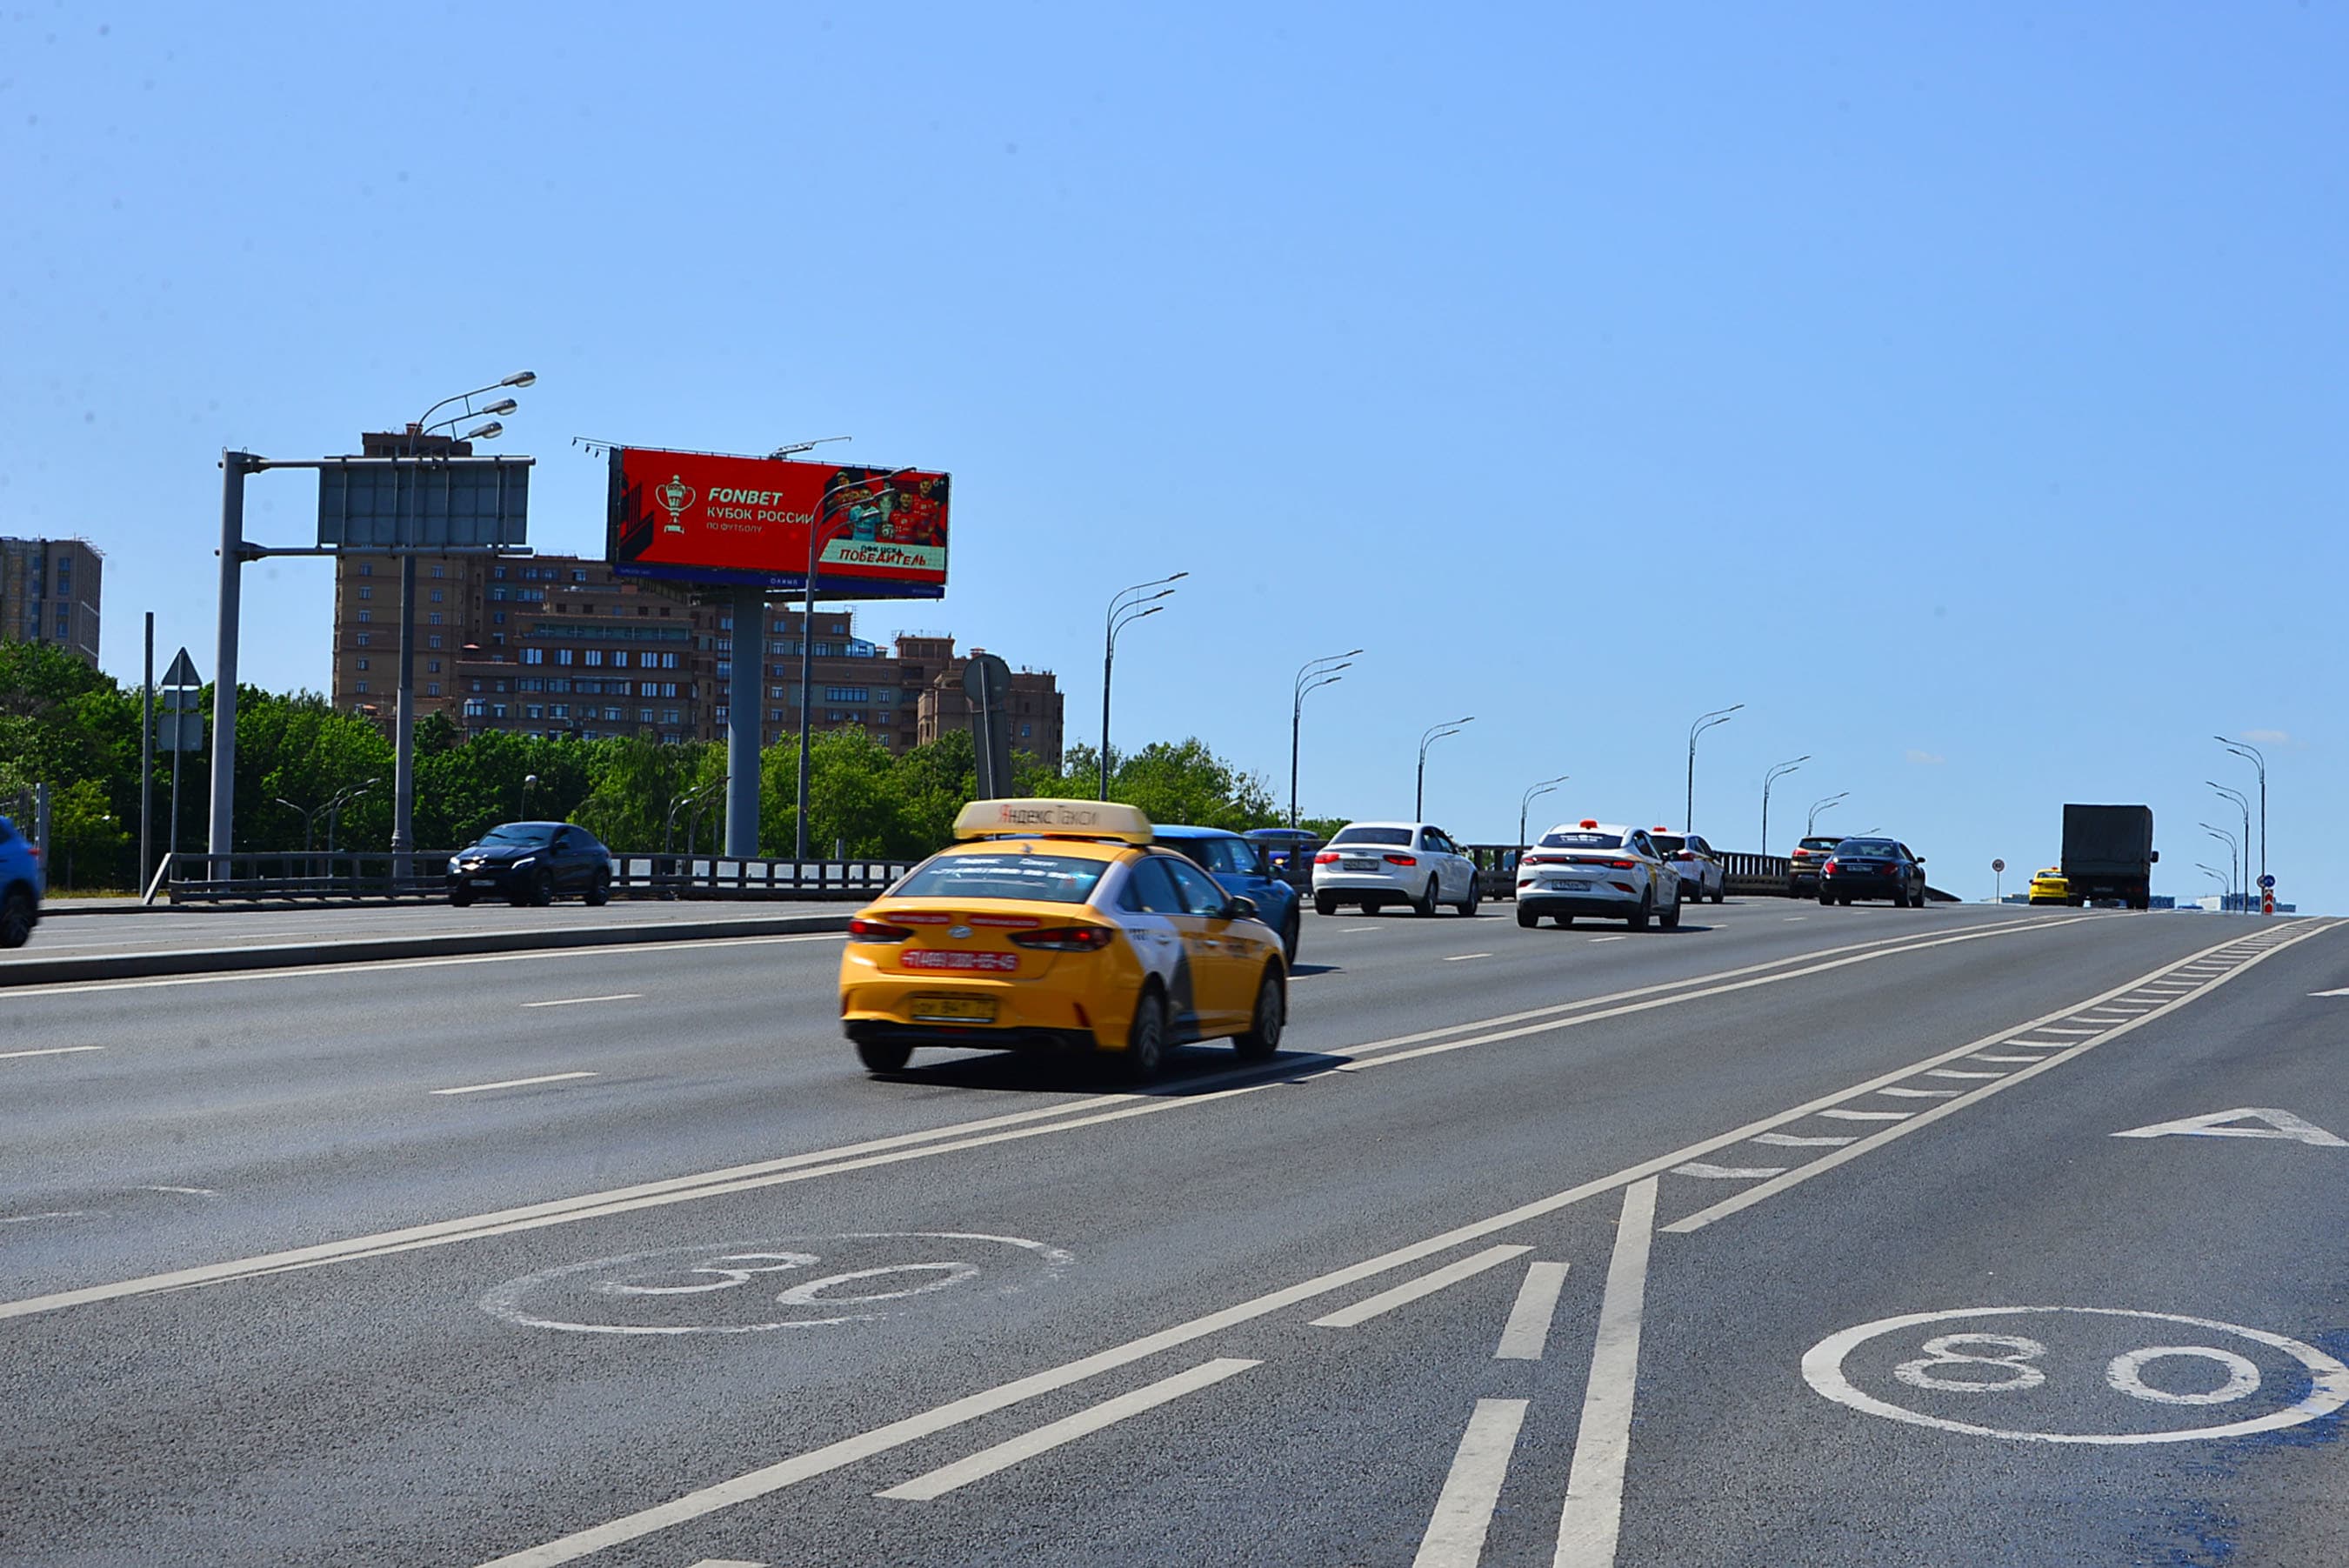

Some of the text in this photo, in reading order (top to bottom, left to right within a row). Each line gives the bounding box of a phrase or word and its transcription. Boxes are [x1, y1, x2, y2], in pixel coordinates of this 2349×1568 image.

[708, 487, 784, 506] FONBET
[706, 506, 814, 524] КУБОК РОССИИ
[720, 523, 763, 533] ФУТБОЛУ
[838, 549, 926, 566] ПОБЕДИТЕЛЬ
[999, 804, 1099, 825] Яндекс Такси
[1894, 1332, 2262, 1405] 80
